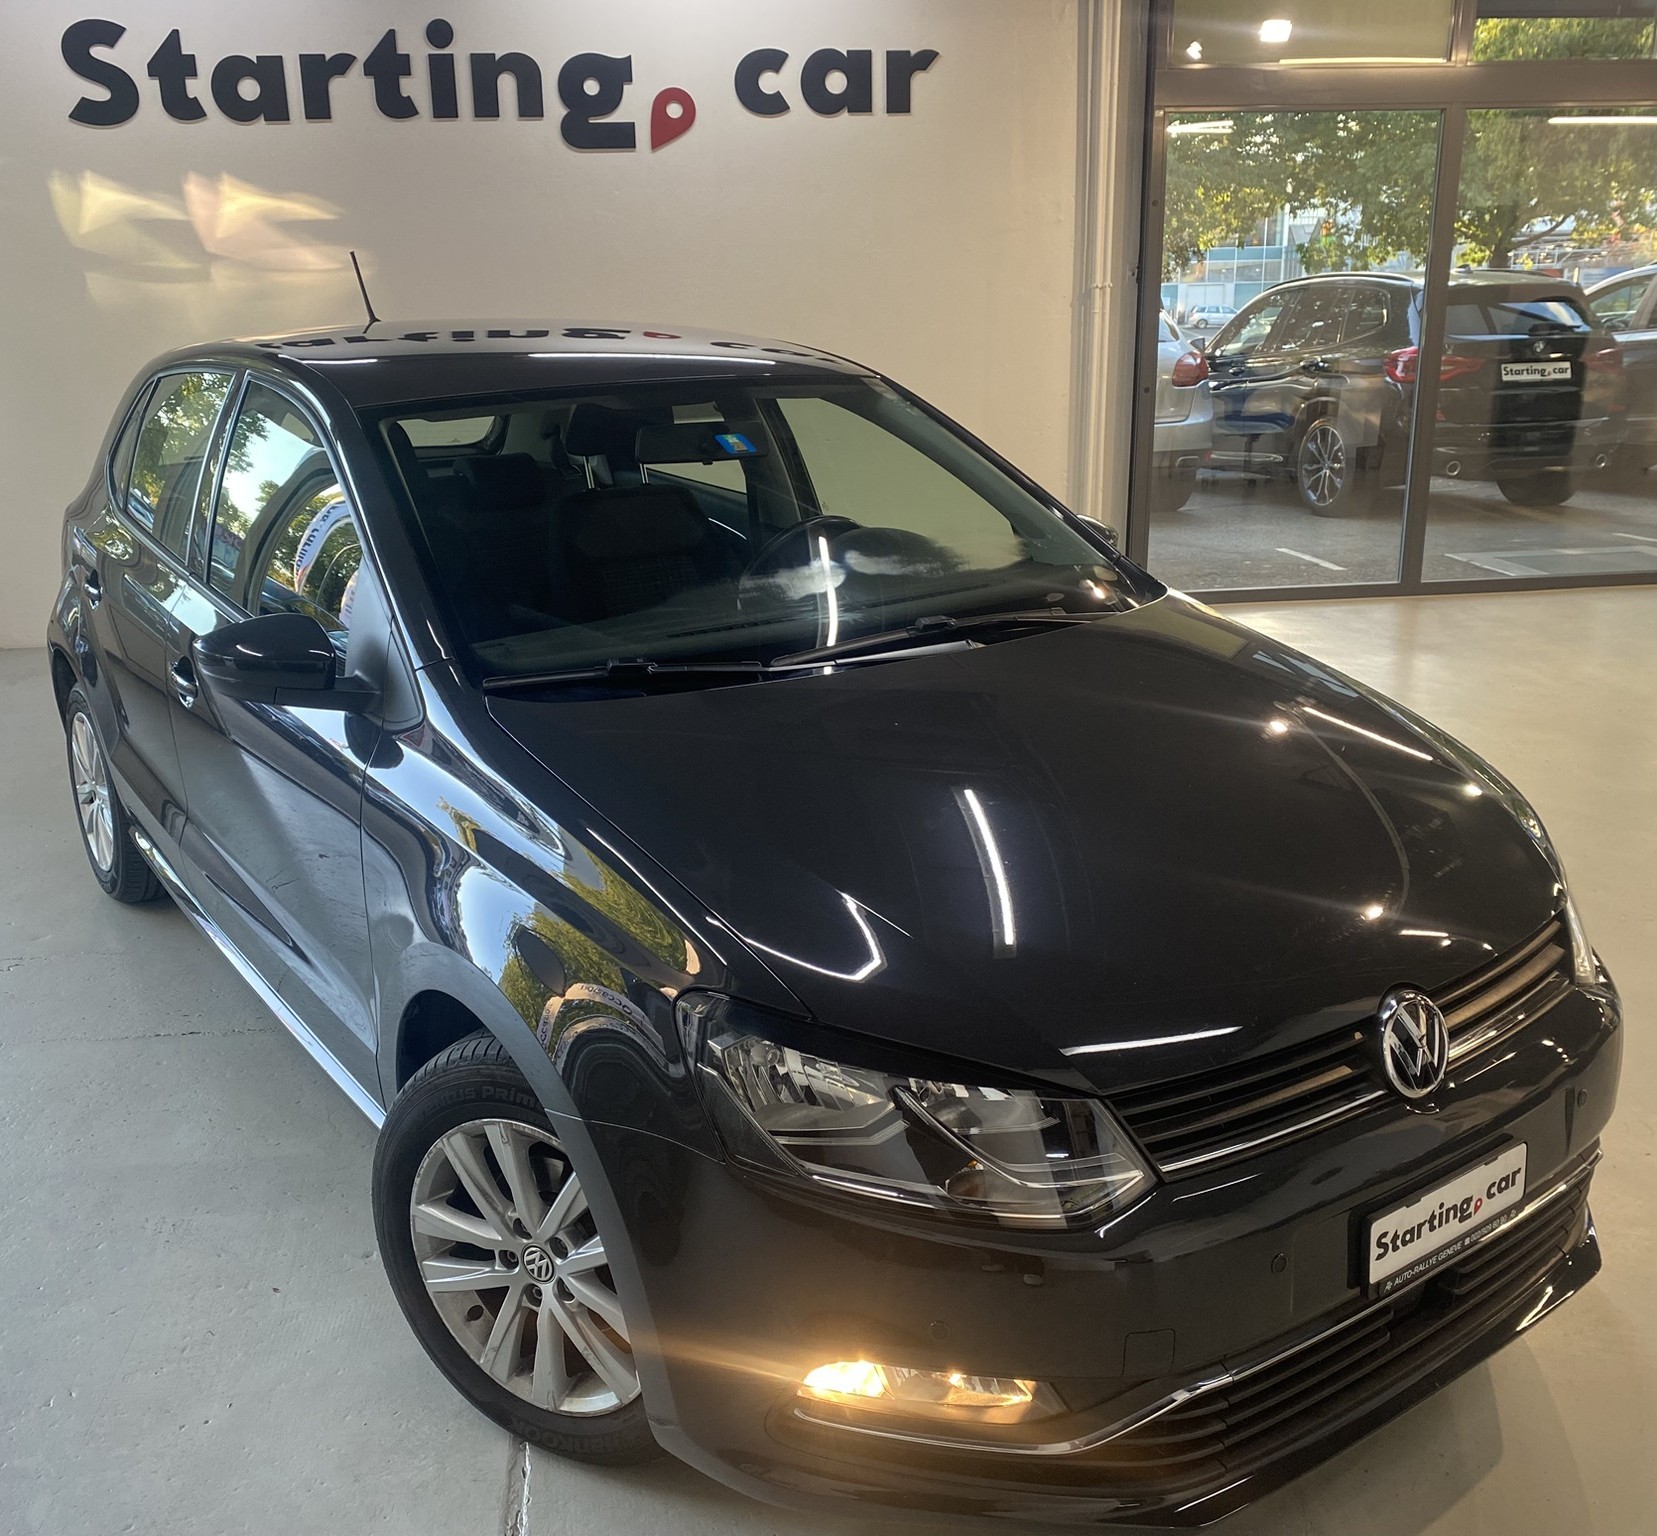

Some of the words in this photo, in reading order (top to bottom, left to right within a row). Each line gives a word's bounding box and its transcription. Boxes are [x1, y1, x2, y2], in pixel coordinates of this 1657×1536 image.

[62, 19, 636, 149] Starting
[735, 49, 939, 115] car
[1503, 365, 1548, 377] Starting
[1553, 366, 1570, 375] car
[1375, 1195, 1474, 1261] Starting
[1486, 1168, 1522, 1200] car
